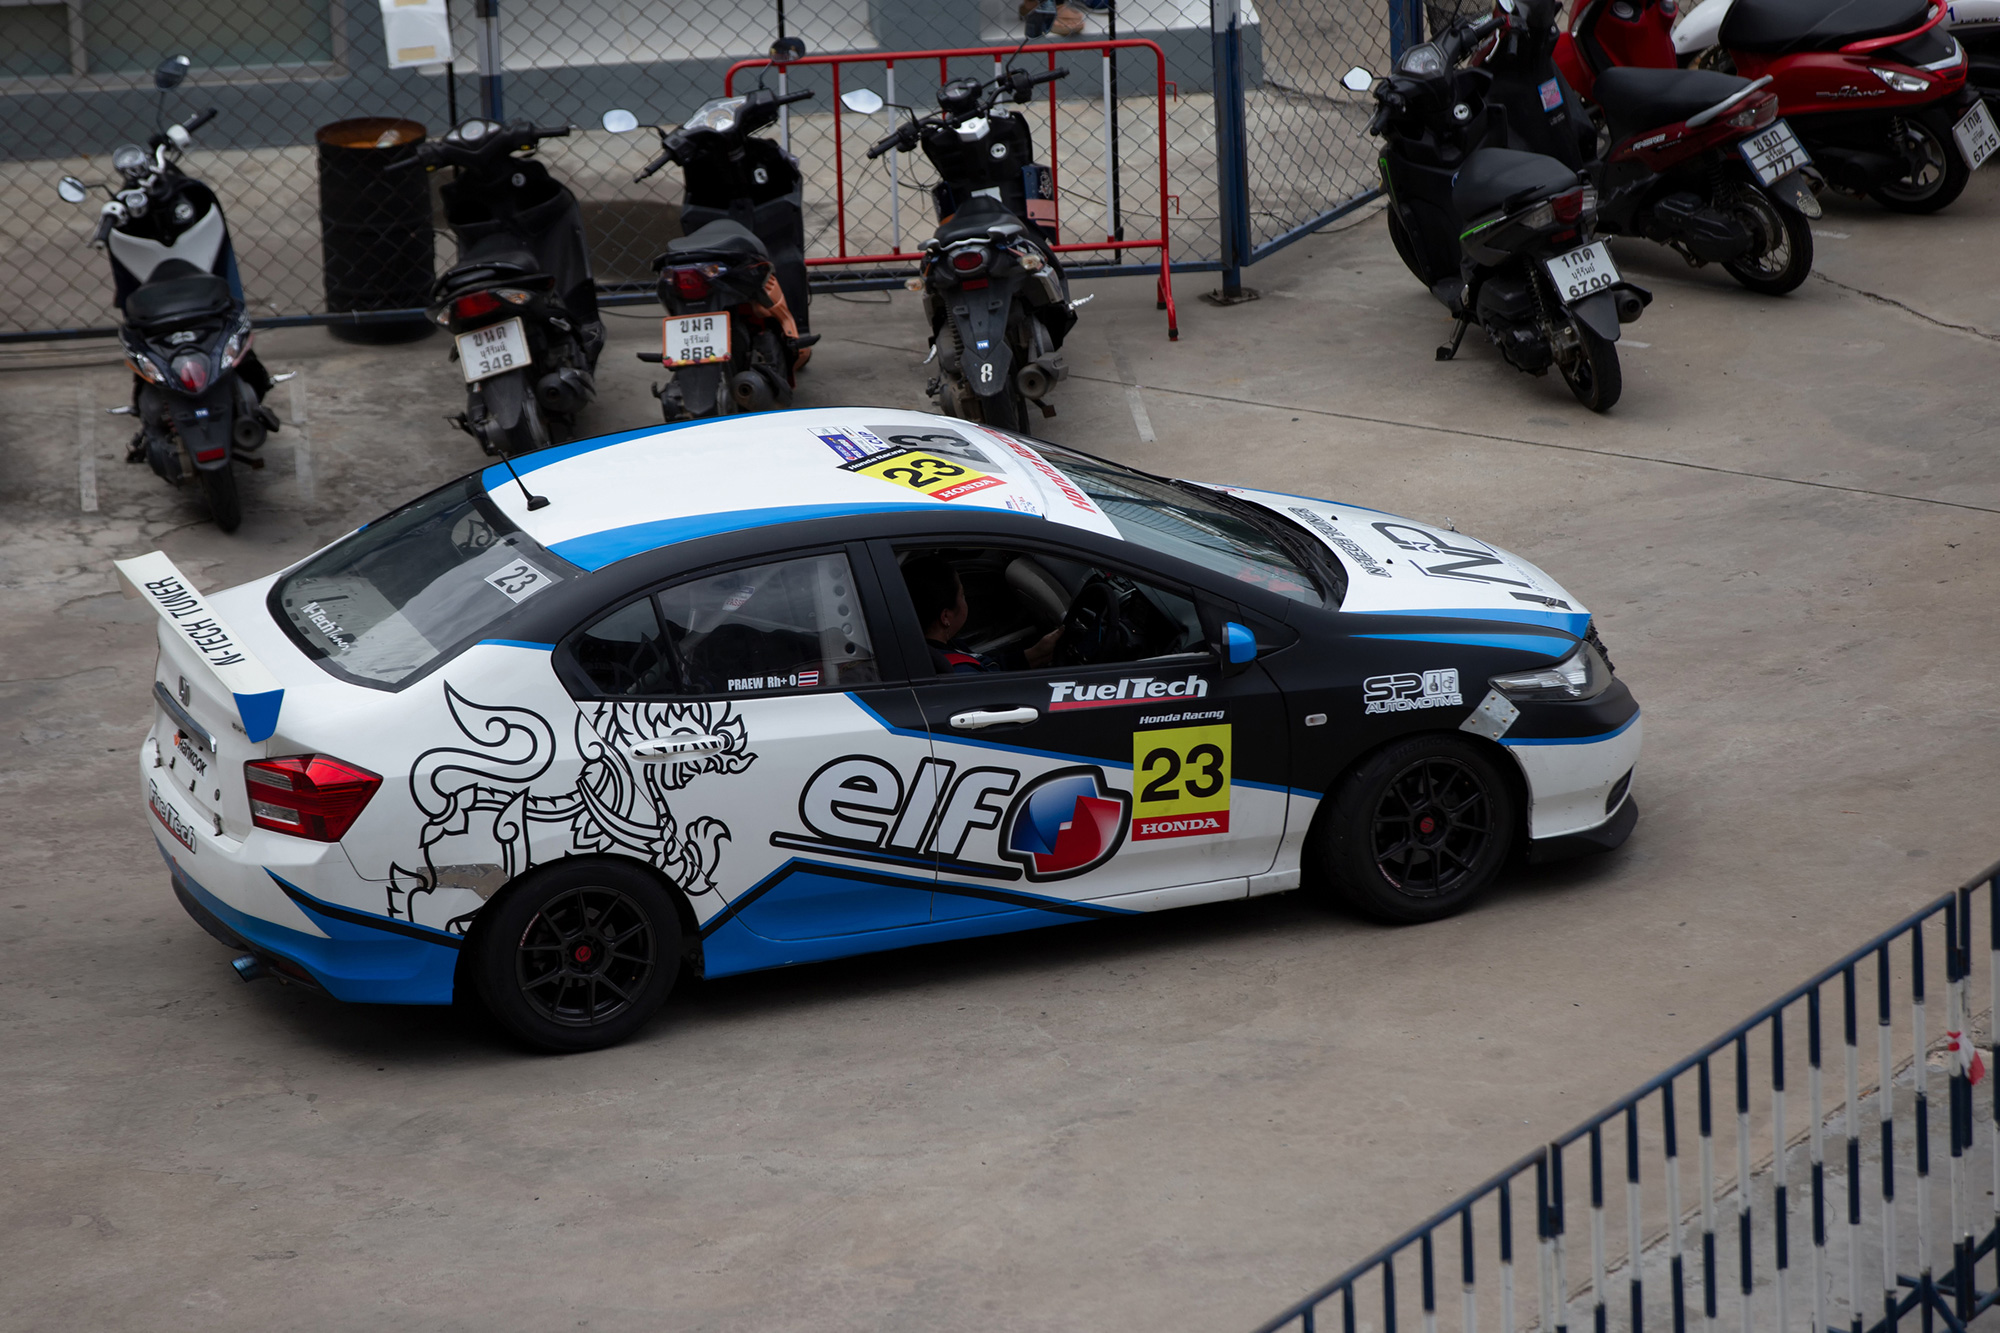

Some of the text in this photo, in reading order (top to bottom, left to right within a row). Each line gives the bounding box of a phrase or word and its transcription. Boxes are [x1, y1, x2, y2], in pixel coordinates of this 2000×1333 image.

[1973, 133, 1997, 163] 6715
[1768, 152, 1795, 176] 777
[1568, 273, 1612, 298] 6700
[479, 354, 513, 374] 348
[680, 346, 714, 361] 868
[981, 363, 993, 383] 8
[848, 457, 877, 471] Honda
[882, 459, 965, 488] 23
[939, 479, 996, 499] HONDA
[493, 565, 538, 594] 23
[144, 576, 246, 666] N-TECH TUNER
[728, 677, 764, 691] PRAEW
[767, 675, 788, 689] Rh+
[1048, 675, 1209, 703] FuelTech
[1365, 693, 1463, 714] AUTOMOTIVE
[1139, 710, 1225, 725] Honda Racing
[1140, 743, 1224, 803] 23
[149, 778, 196, 854] FuelTech
[799, 754, 1021, 861] elf
[1140, 818, 1220, 835] HONDA
